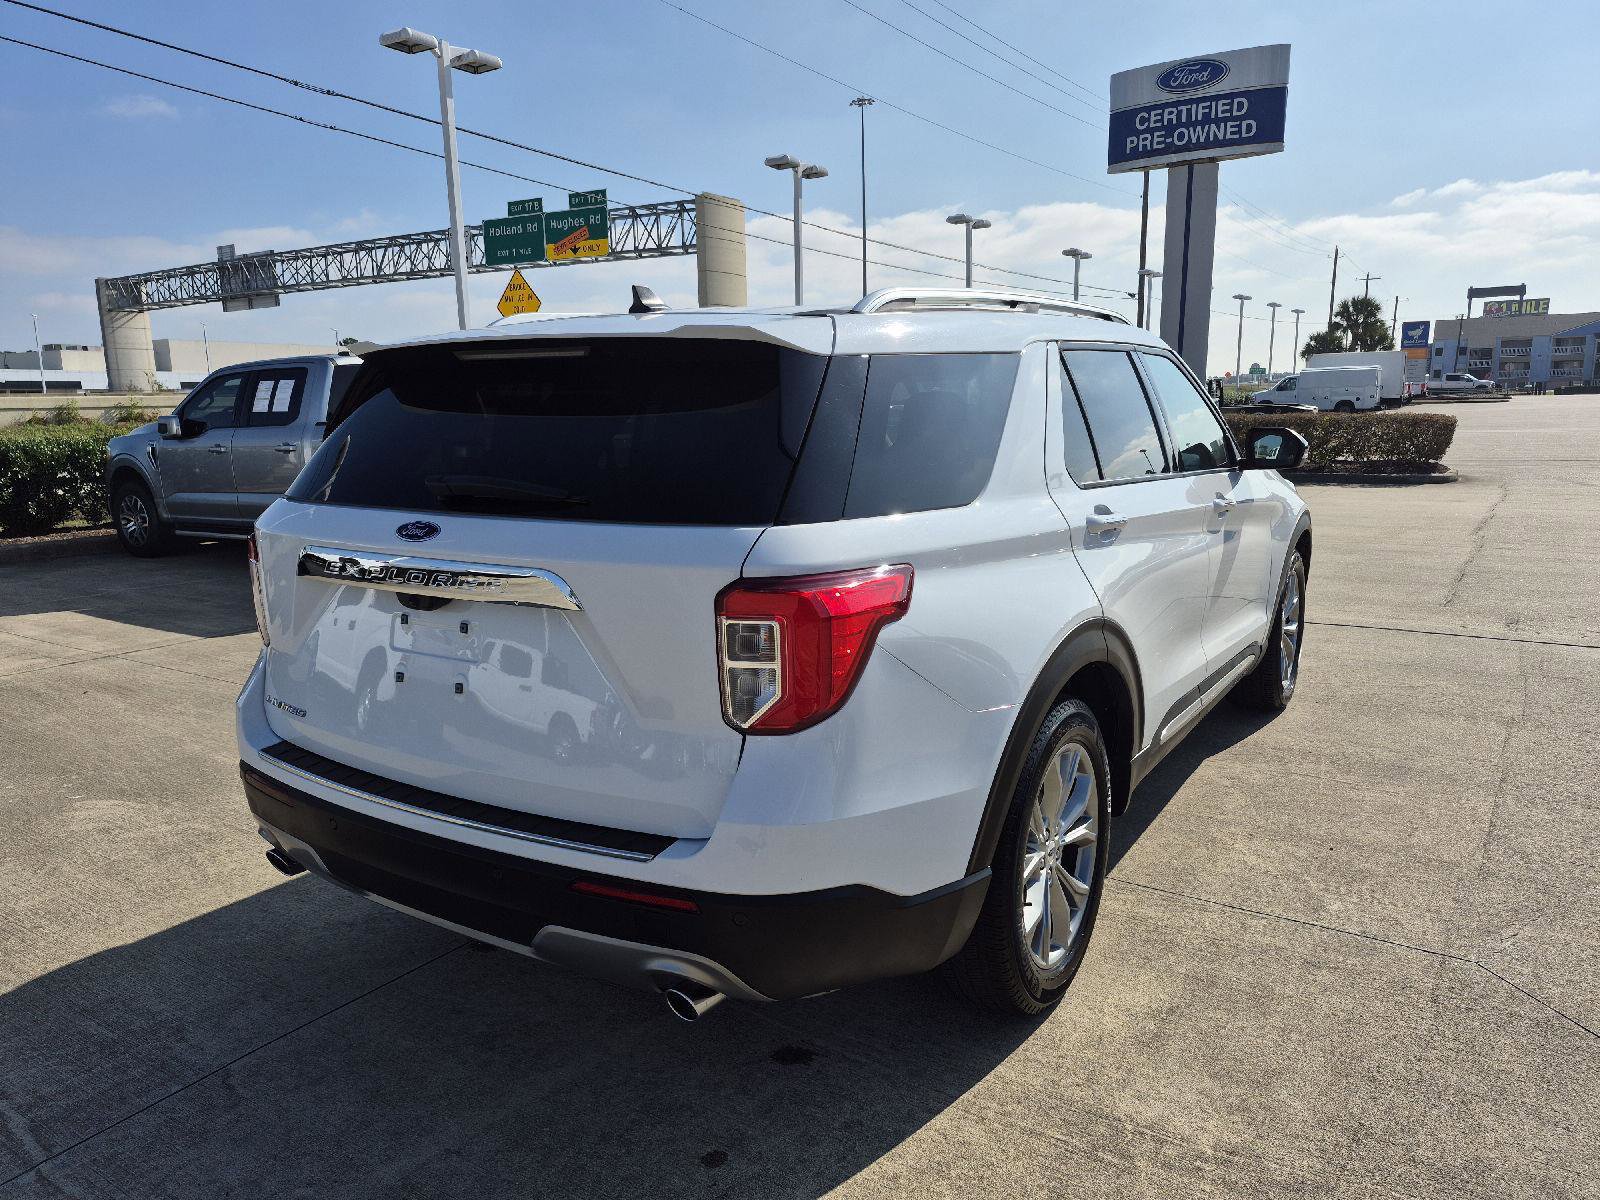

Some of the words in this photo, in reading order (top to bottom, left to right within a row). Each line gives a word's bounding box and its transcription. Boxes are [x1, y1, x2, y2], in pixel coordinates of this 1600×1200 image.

[1170, 65, 1212, 87] Ford
[1135, 97, 1249, 130] CERTIFIED
[1126, 119, 1257, 154] PRE-OWNED
[511, 204, 523, 212] EXIT
[489, 223, 523, 237] Holland
[526, 222, 538, 233] Rd
[550, 216, 585, 232] Hughes
[589, 214, 601, 225] Rd
[497, 249, 509, 257] EXIT
[512, 248, 516, 257] 1
[518, 247, 532, 255] MILE
[582, 243, 601, 253] ONLY
[402, 523, 429, 537] Ford
[324, 560, 511, 594] EXPLORER
